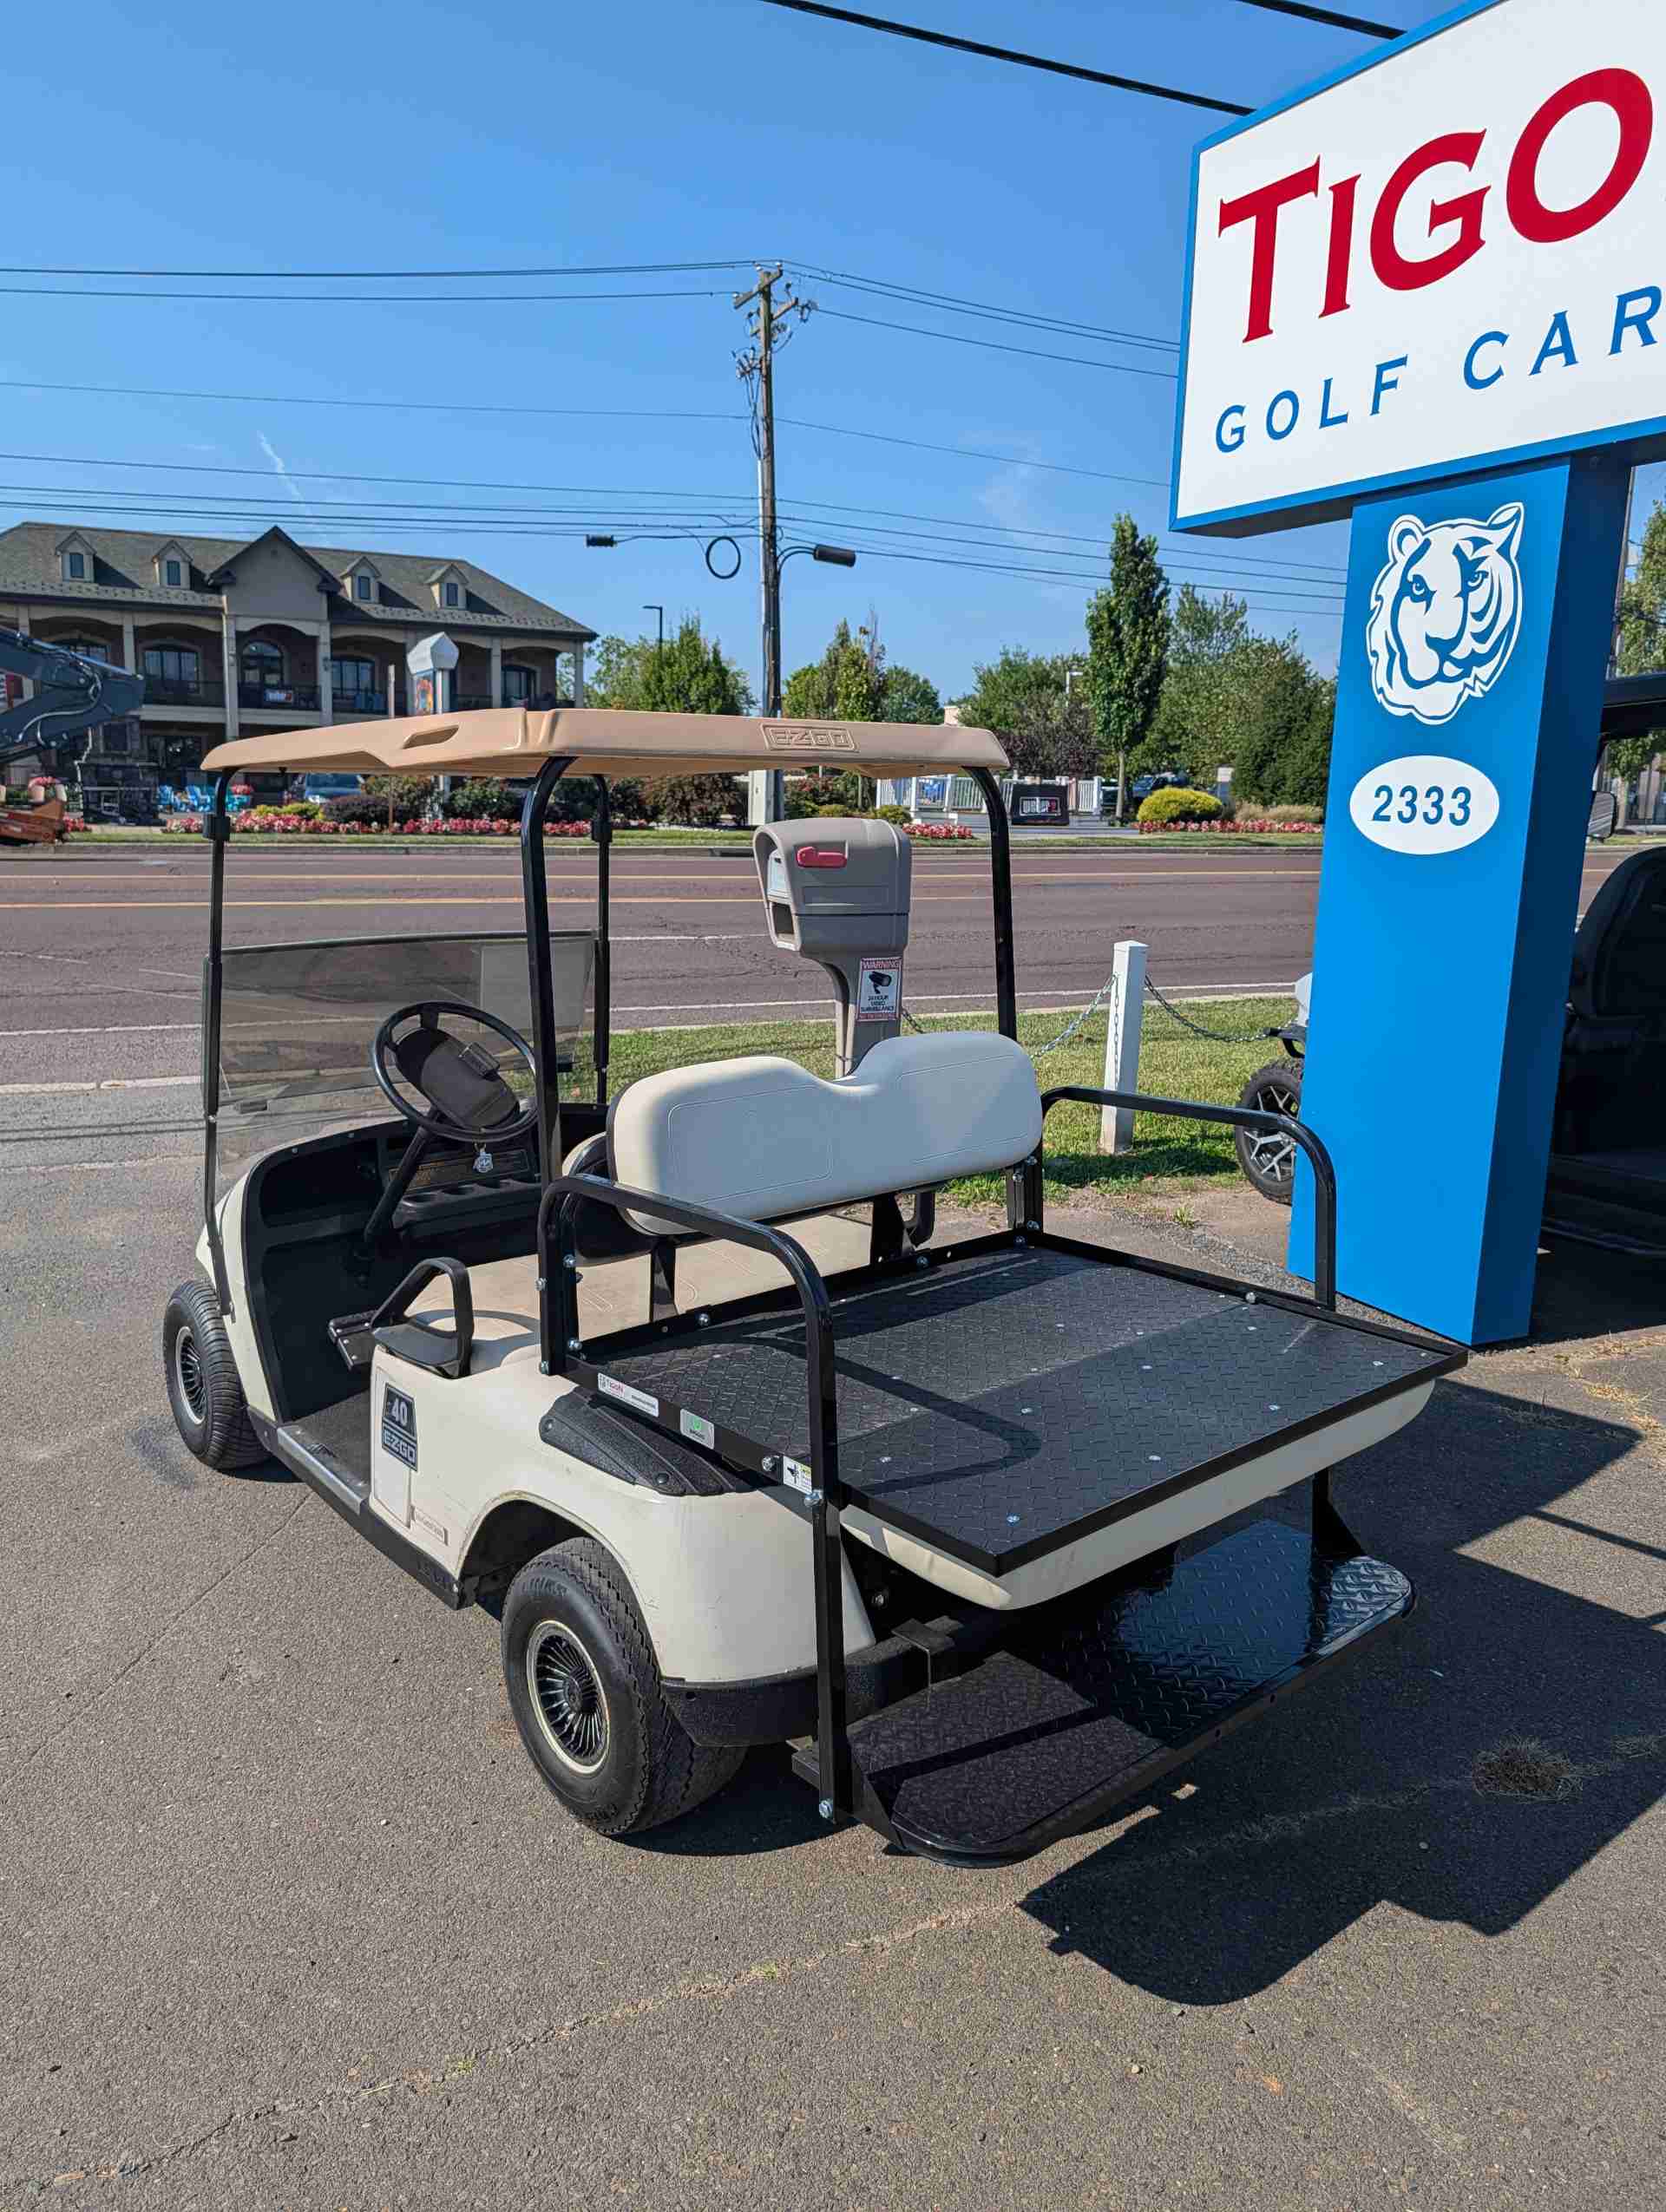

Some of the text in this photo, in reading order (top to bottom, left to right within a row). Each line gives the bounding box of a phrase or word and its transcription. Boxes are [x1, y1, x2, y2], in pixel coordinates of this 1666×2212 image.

[1215, 285, 1663, 454] GOLF CAR
[1372, 783, 1473, 827] 2333
[391, 1397, 408, 1426] 40
